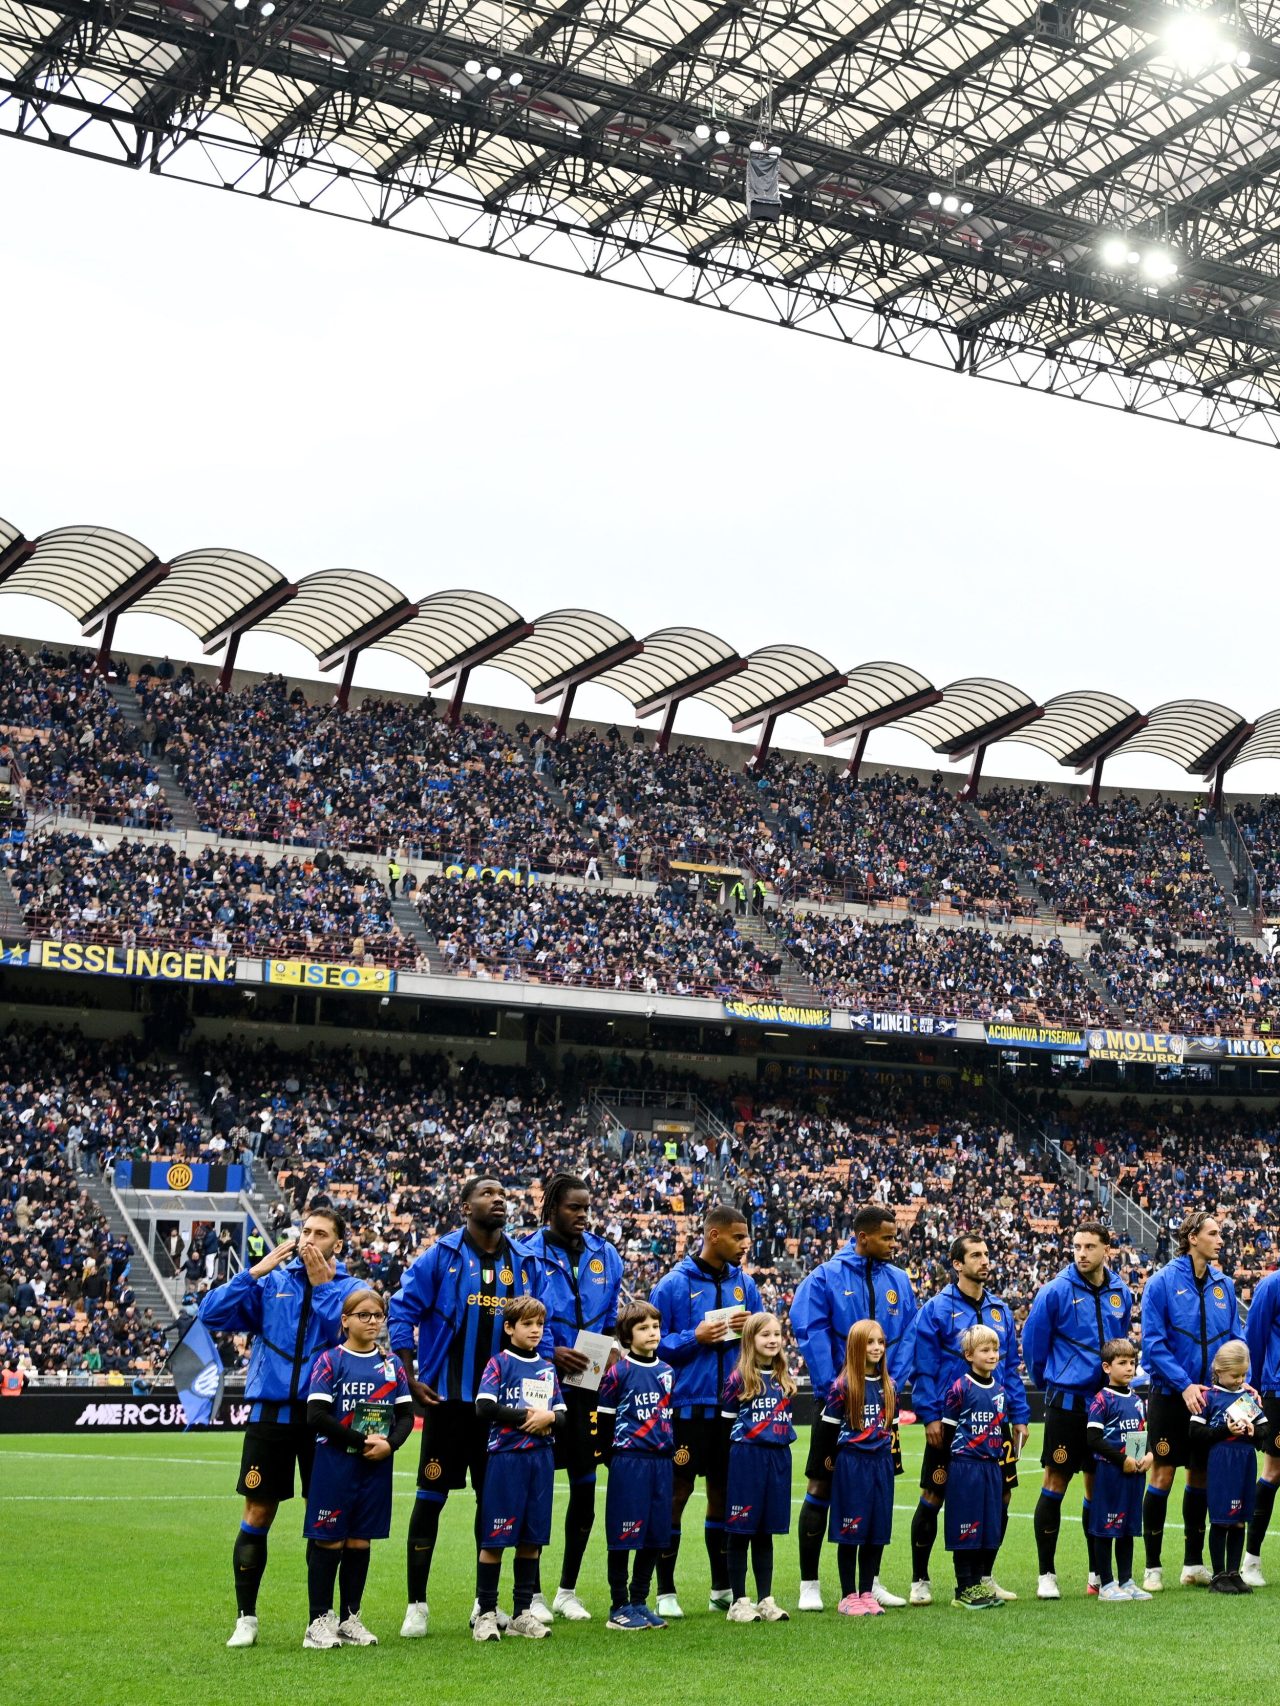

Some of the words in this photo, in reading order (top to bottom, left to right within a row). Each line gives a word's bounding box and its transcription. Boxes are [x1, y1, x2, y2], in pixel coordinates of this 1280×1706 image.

[41, 940, 227, 982] ESSLINGEN
[300, 965, 360, 987] ISEO
[758, 1006, 777, 1021] SAN
[779, 1006, 824, 1026] GIOVANNI
[873, 1013, 911, 1032] CUNEO
[988, 1025, 1037, 1043] ACQUAVIVA
[1039, 1029, 1081, 1045] D'ISERNIA
[1106, 1031, 1168, 1053] MOLE
[1228, 1039, 1265, 1055] INTER
[467, 1291, 514, 1308] etsso
[342, 1382, 375, 1396] KEEP
[506, 1386, 520, 1400] KE
[634, 1391, 660, 1406] KEEP
[752, 1397, 778, 1410] KEEP
[862, 1403, 881, 1415] EEP
[971, 1411, 994, 1423] KEEP
[1119, 1418, 1139, 1431] KEEP
[772, 1423, 788, 1436] OUT
[971, 1424, 1002, 1436] RACIS
